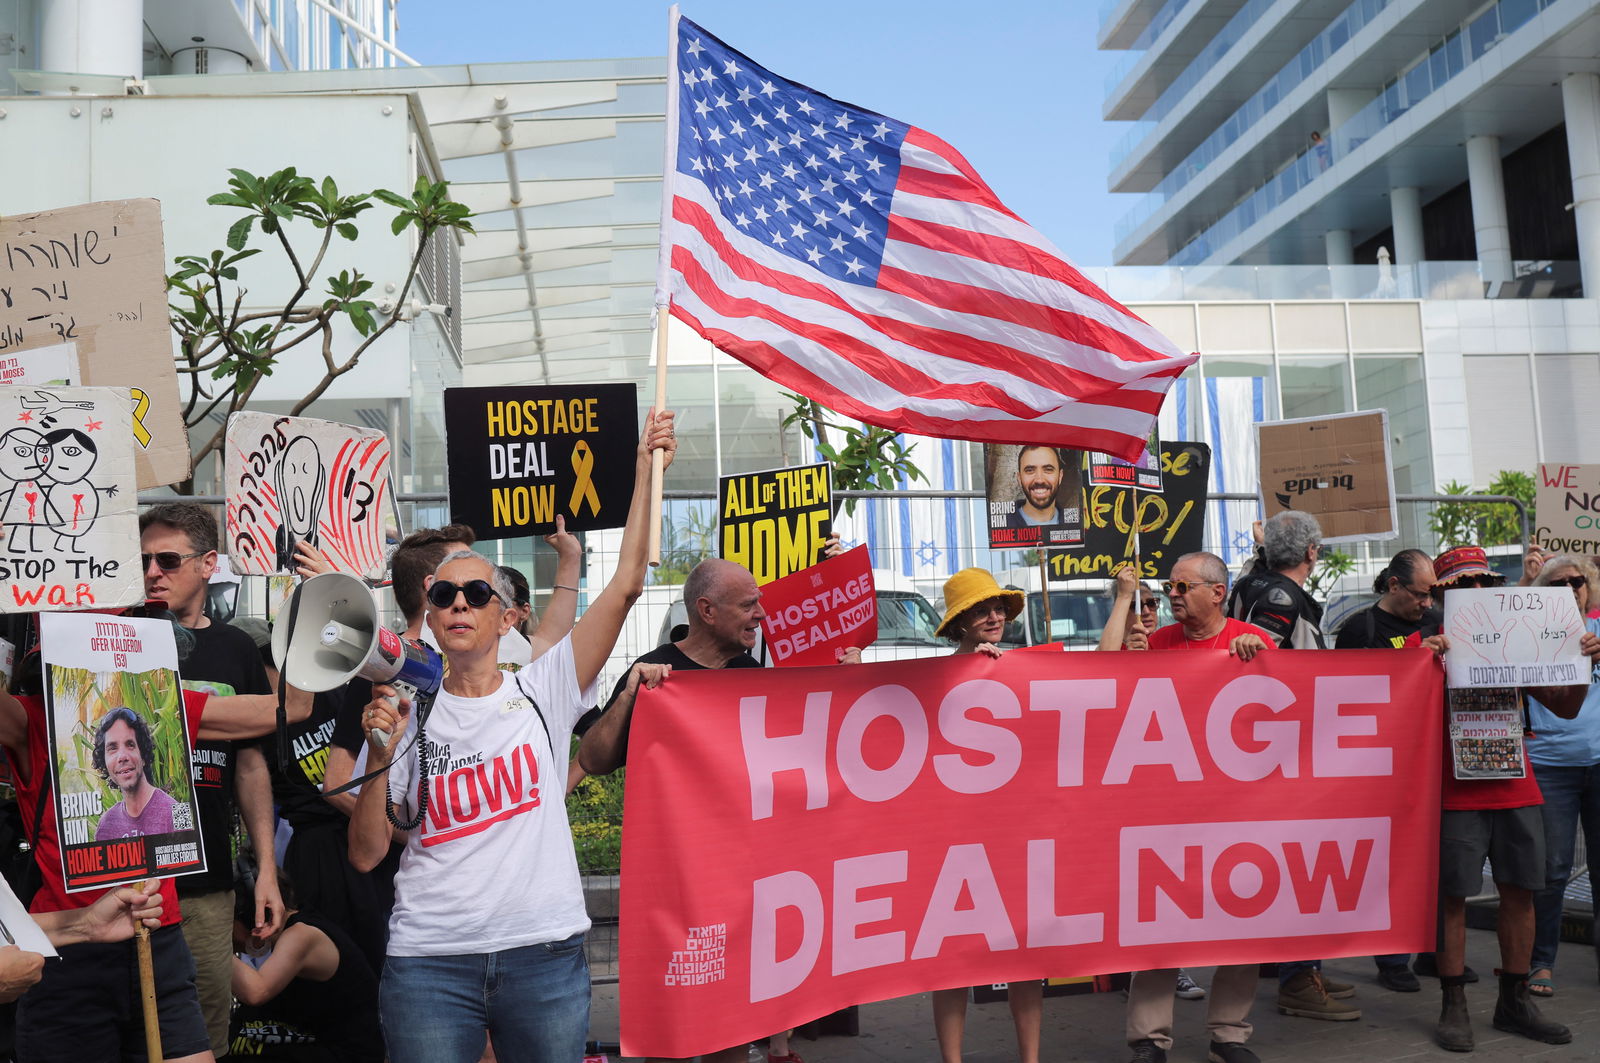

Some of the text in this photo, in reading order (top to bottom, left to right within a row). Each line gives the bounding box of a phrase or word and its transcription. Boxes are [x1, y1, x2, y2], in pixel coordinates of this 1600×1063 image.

[3, 367, 25, 379] MOSES
[487, 398, 599, 437] HOSTAGE
[489, 441, 555, 480] DEAL
[1093, 466, 1115, 478] HOME
[1116, 466, 1135, 480] NOW!
[1542, 465, 1580, 488] WE
[724, 466, 829, 518] ALL OF THEM
[492, 484, 555, 527] NOW
[990, 501, 1016, 515] BRING
[991, 514, 1007, 527] HIM
[991, 529, 1015, 542] HOME
[1017, 526, 1042, 541] NOW!
[0, 558, 55, 582] STOP
[1051, 554, 1112, 576] Them
[766, 573, 871, 634] HOSTAGE
[774, 621, 843, 660] DEAL
[843, 602, 871, 627] NOW
[1473, 633, 1501, 643] HELP
[91, 638, 142, 653] OFER KALDERON
[114, 653, 127, 668] (53)
[192, 750, 210, 764] GADI
[292, 732, 321, 760] ALL
[740, 674, 1393, 820] HOSTAGE
[417, 743, 541, 835] NOW!
[61, 791, 103, 819] BRING
[63, 818, 89, 845] HIM
[67, 837, 147, 875] HOME NOW!
[156, 850, 198, 866] FAMILIES FORUM
[688, 923, 726, 938] מחאת
[750, 838, 1374, 1003] DEAL NOW
[686, 934, 726, 950] הנשים
[672, 946, 725, 962] להחזרת
[668, 957, 725, 974] החטופות
[665, 969, 725, 986] והחטופים
